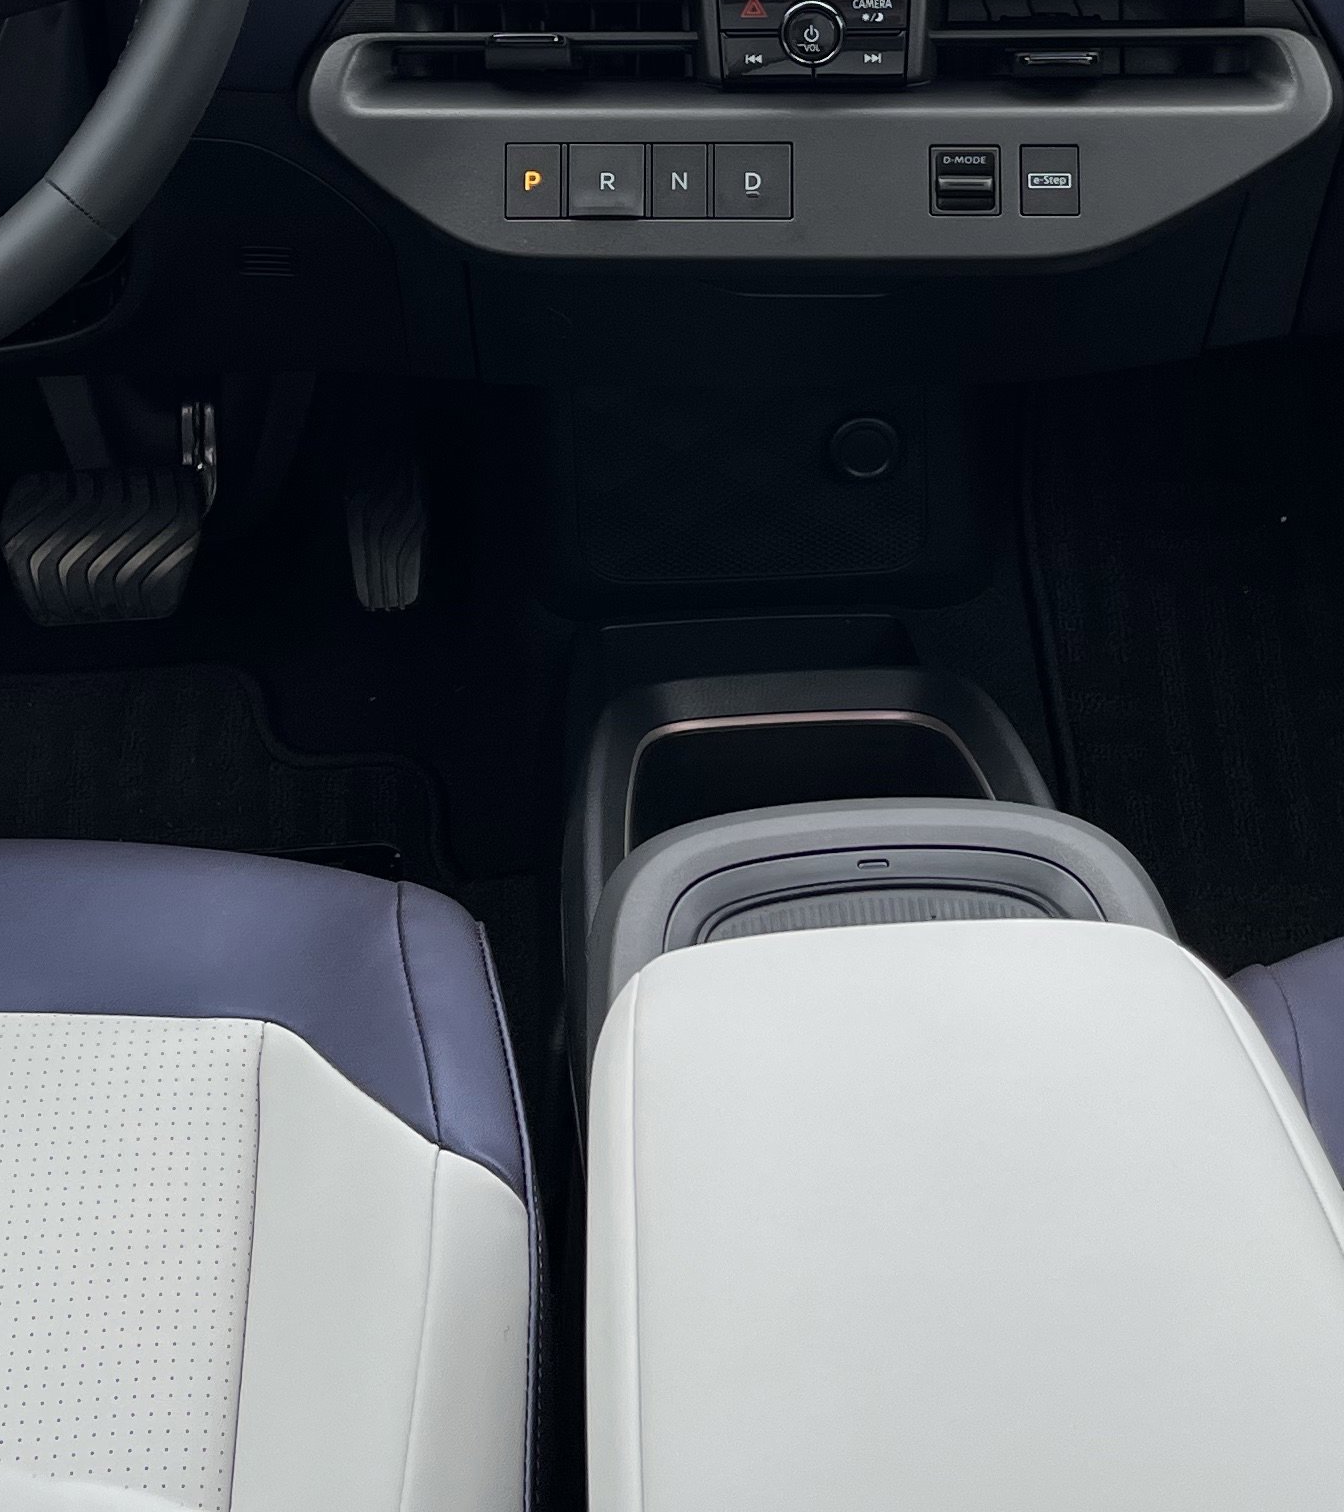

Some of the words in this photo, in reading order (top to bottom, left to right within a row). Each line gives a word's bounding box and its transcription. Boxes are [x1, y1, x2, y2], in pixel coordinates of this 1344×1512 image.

[852, 0, 893, 9] CAMERA
[943, 156, 986, 164] D-MODE
[524, 171, 541, 191] P
[600, 172, 616, 190] R
[671, 172, 688, 190] N
[744, 172, 762, 191] D
[1033, 176, 1067, 186] e-Step
